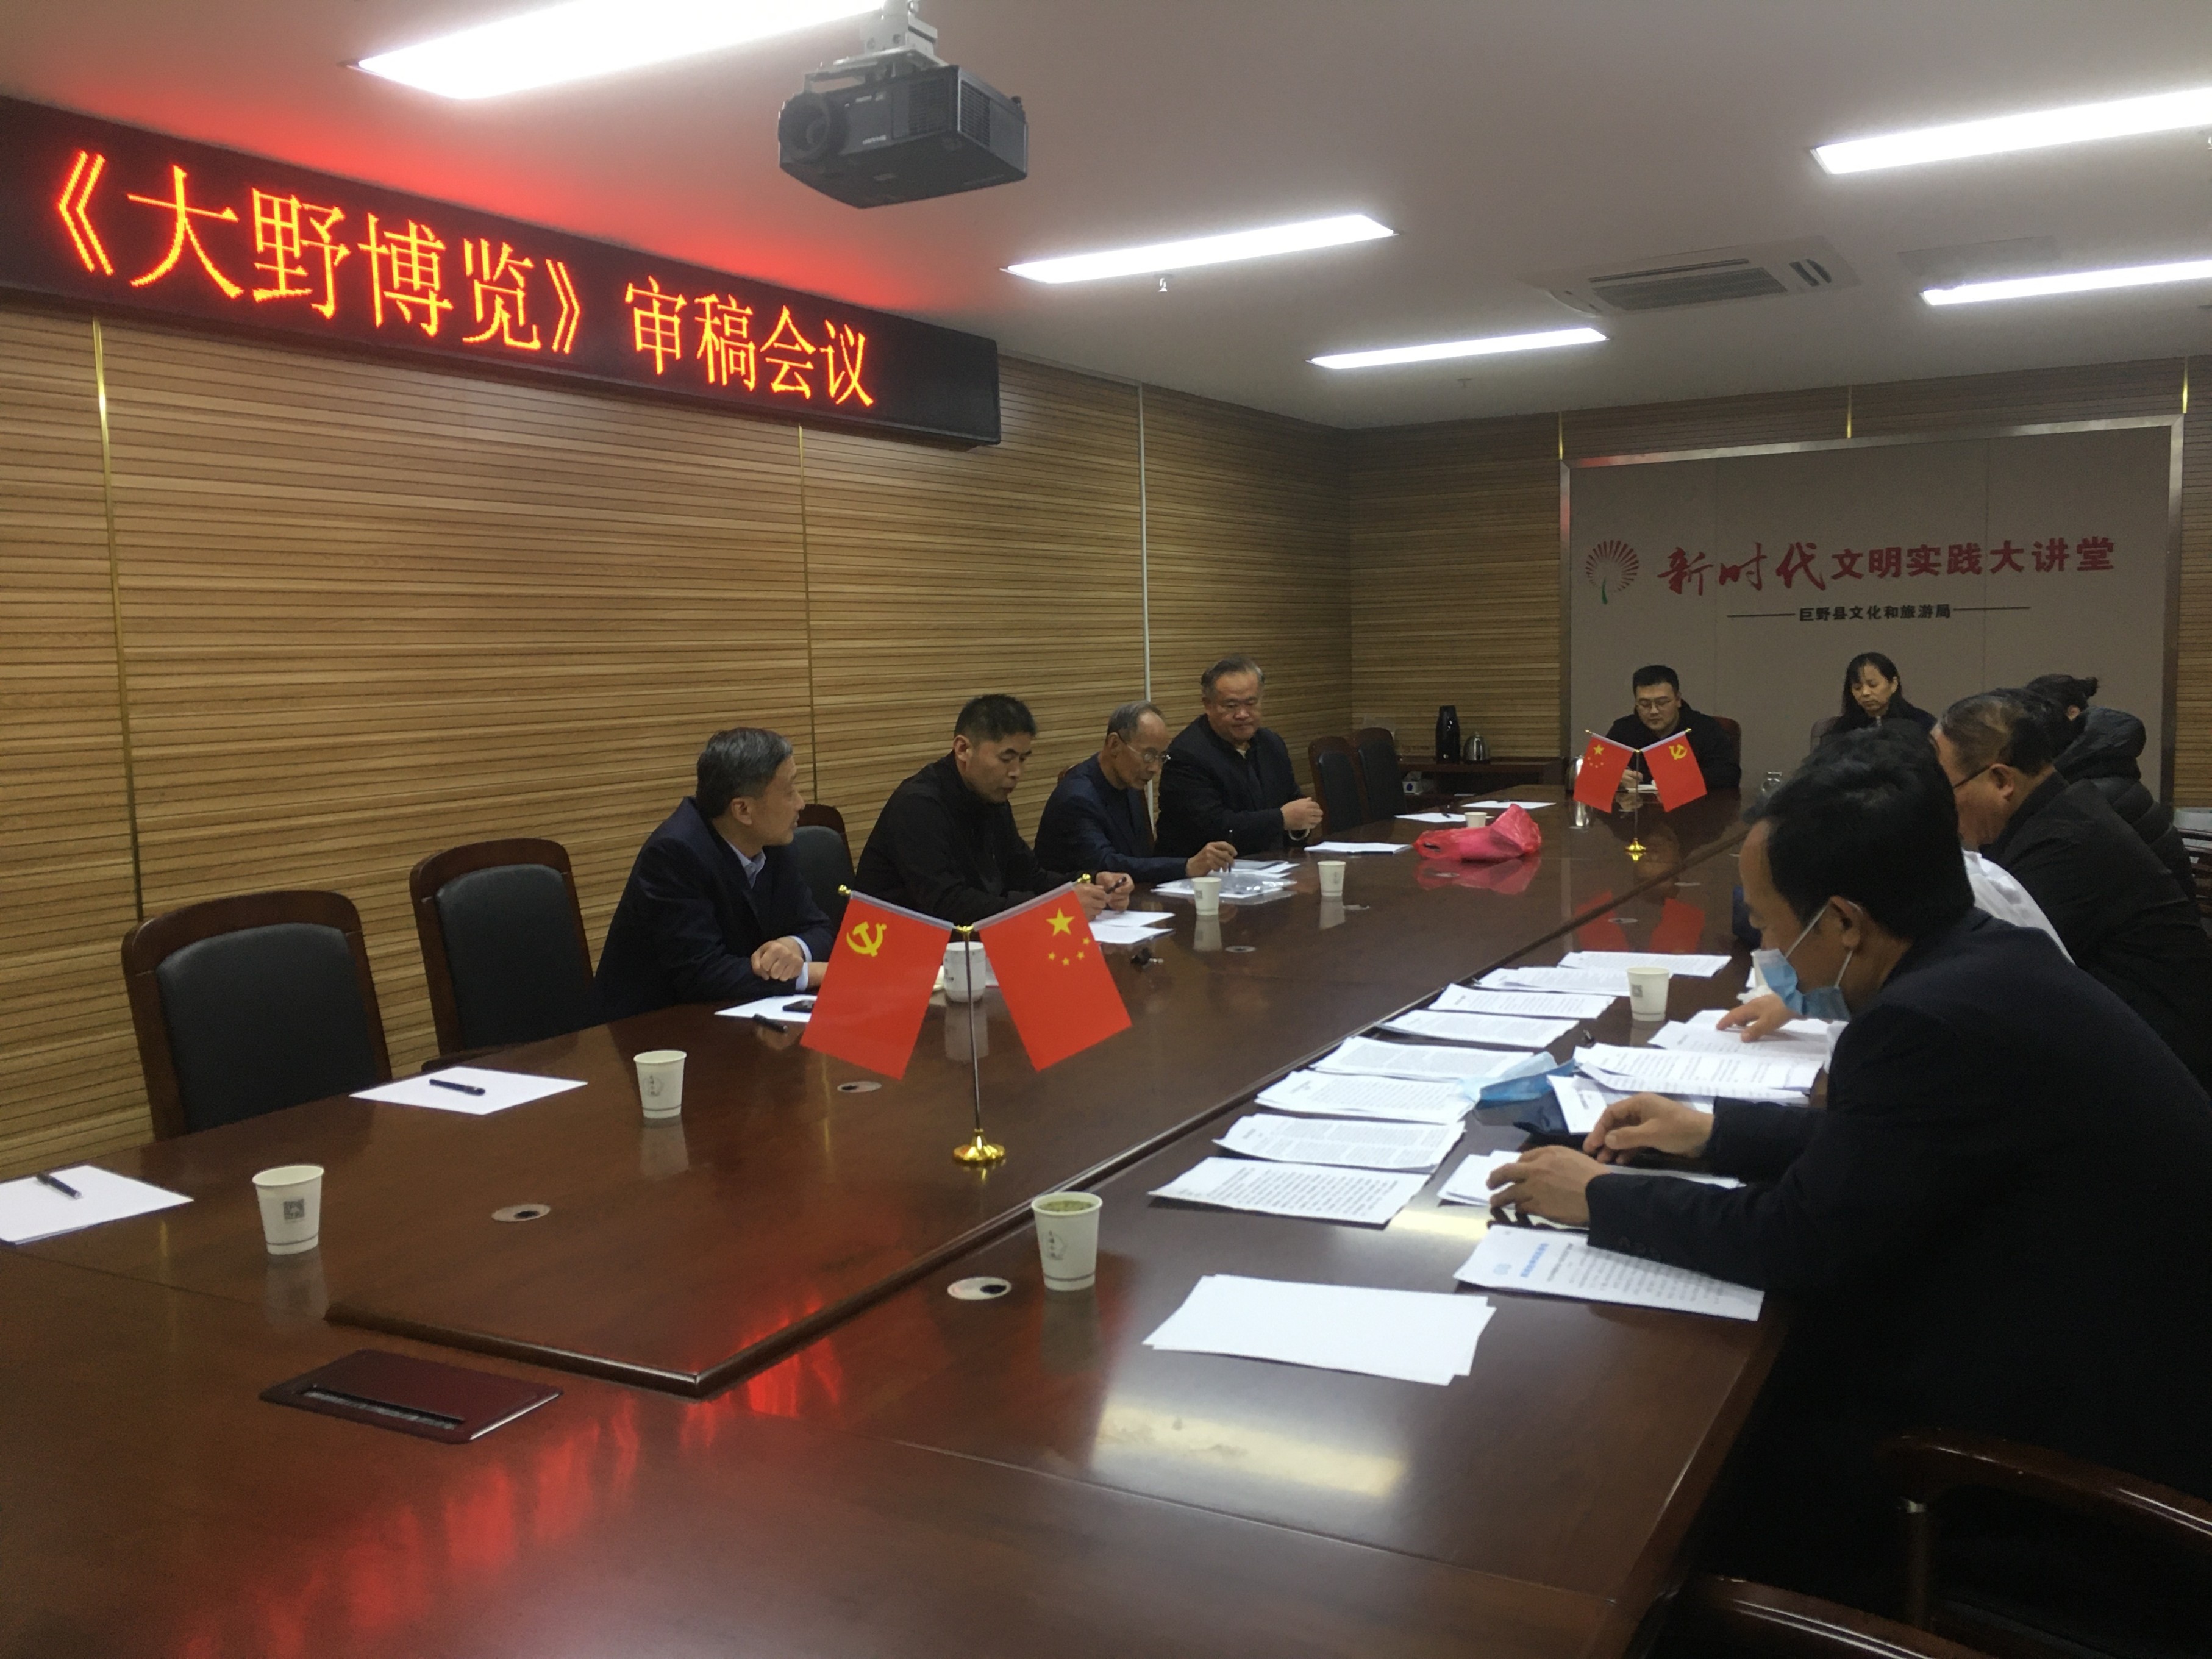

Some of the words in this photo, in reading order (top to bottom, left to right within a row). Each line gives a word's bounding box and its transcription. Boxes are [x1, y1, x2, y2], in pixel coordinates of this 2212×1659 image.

[1656, 536, 2115, 596] 新时代文明实践大讲堂
[1799, 604, 1951, 622] 巨野县文化和旅游局
